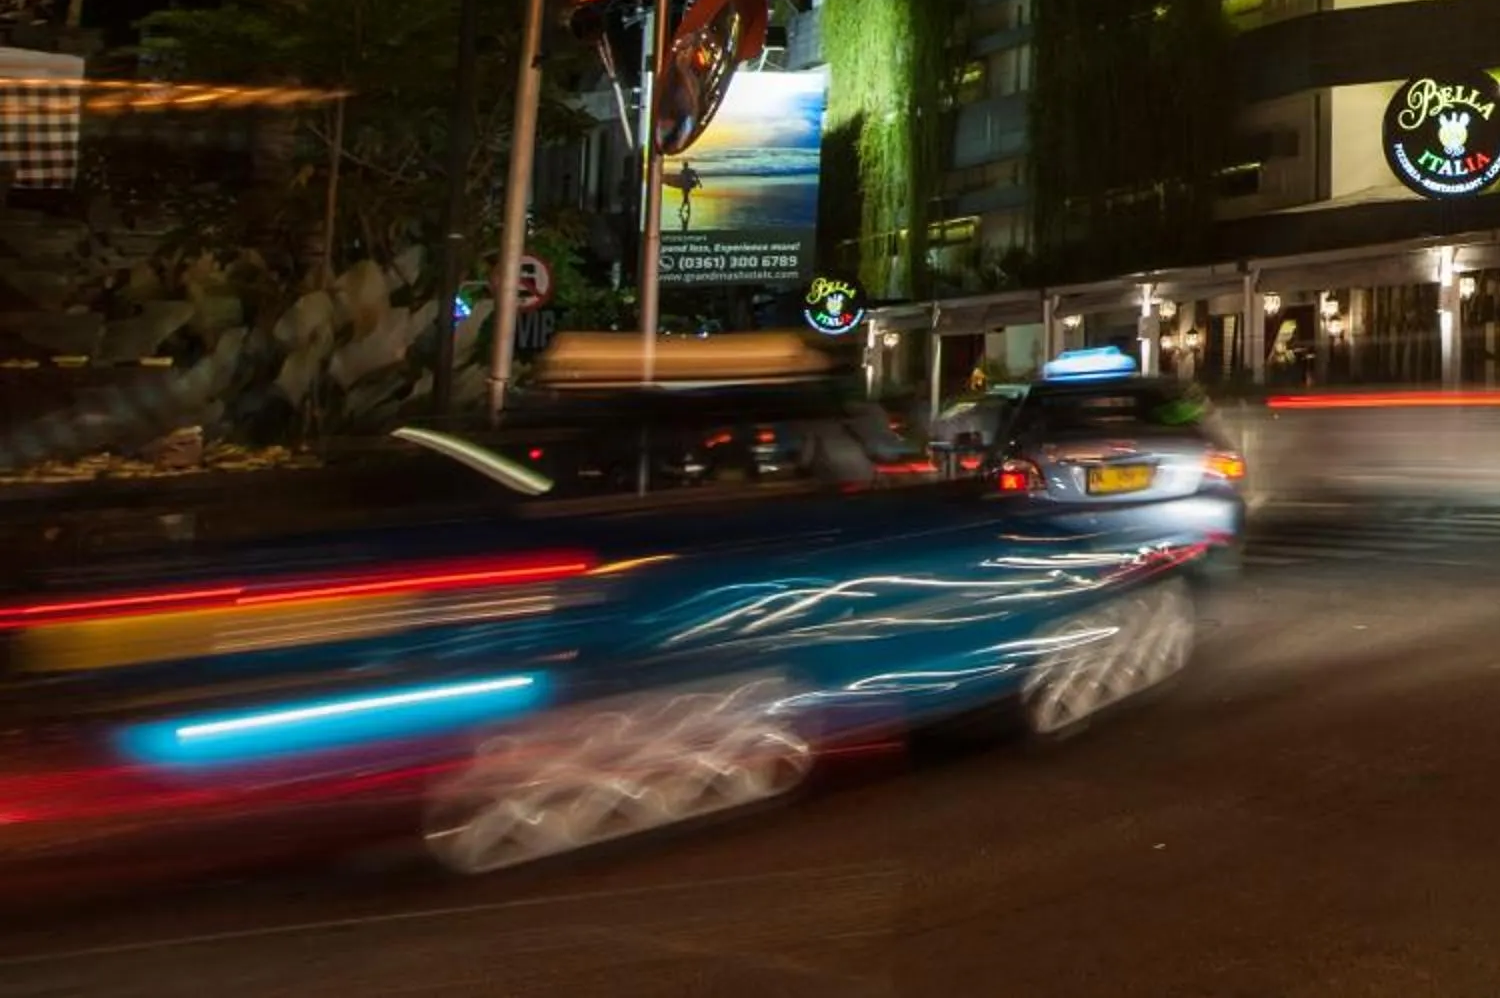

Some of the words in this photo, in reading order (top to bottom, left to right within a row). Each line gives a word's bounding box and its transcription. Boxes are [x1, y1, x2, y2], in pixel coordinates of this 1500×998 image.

[1417, 149, 1492, 177] ITALIA
[678, 255, 726, 271] (0361)
[761, 255, 798, 268] 6789
